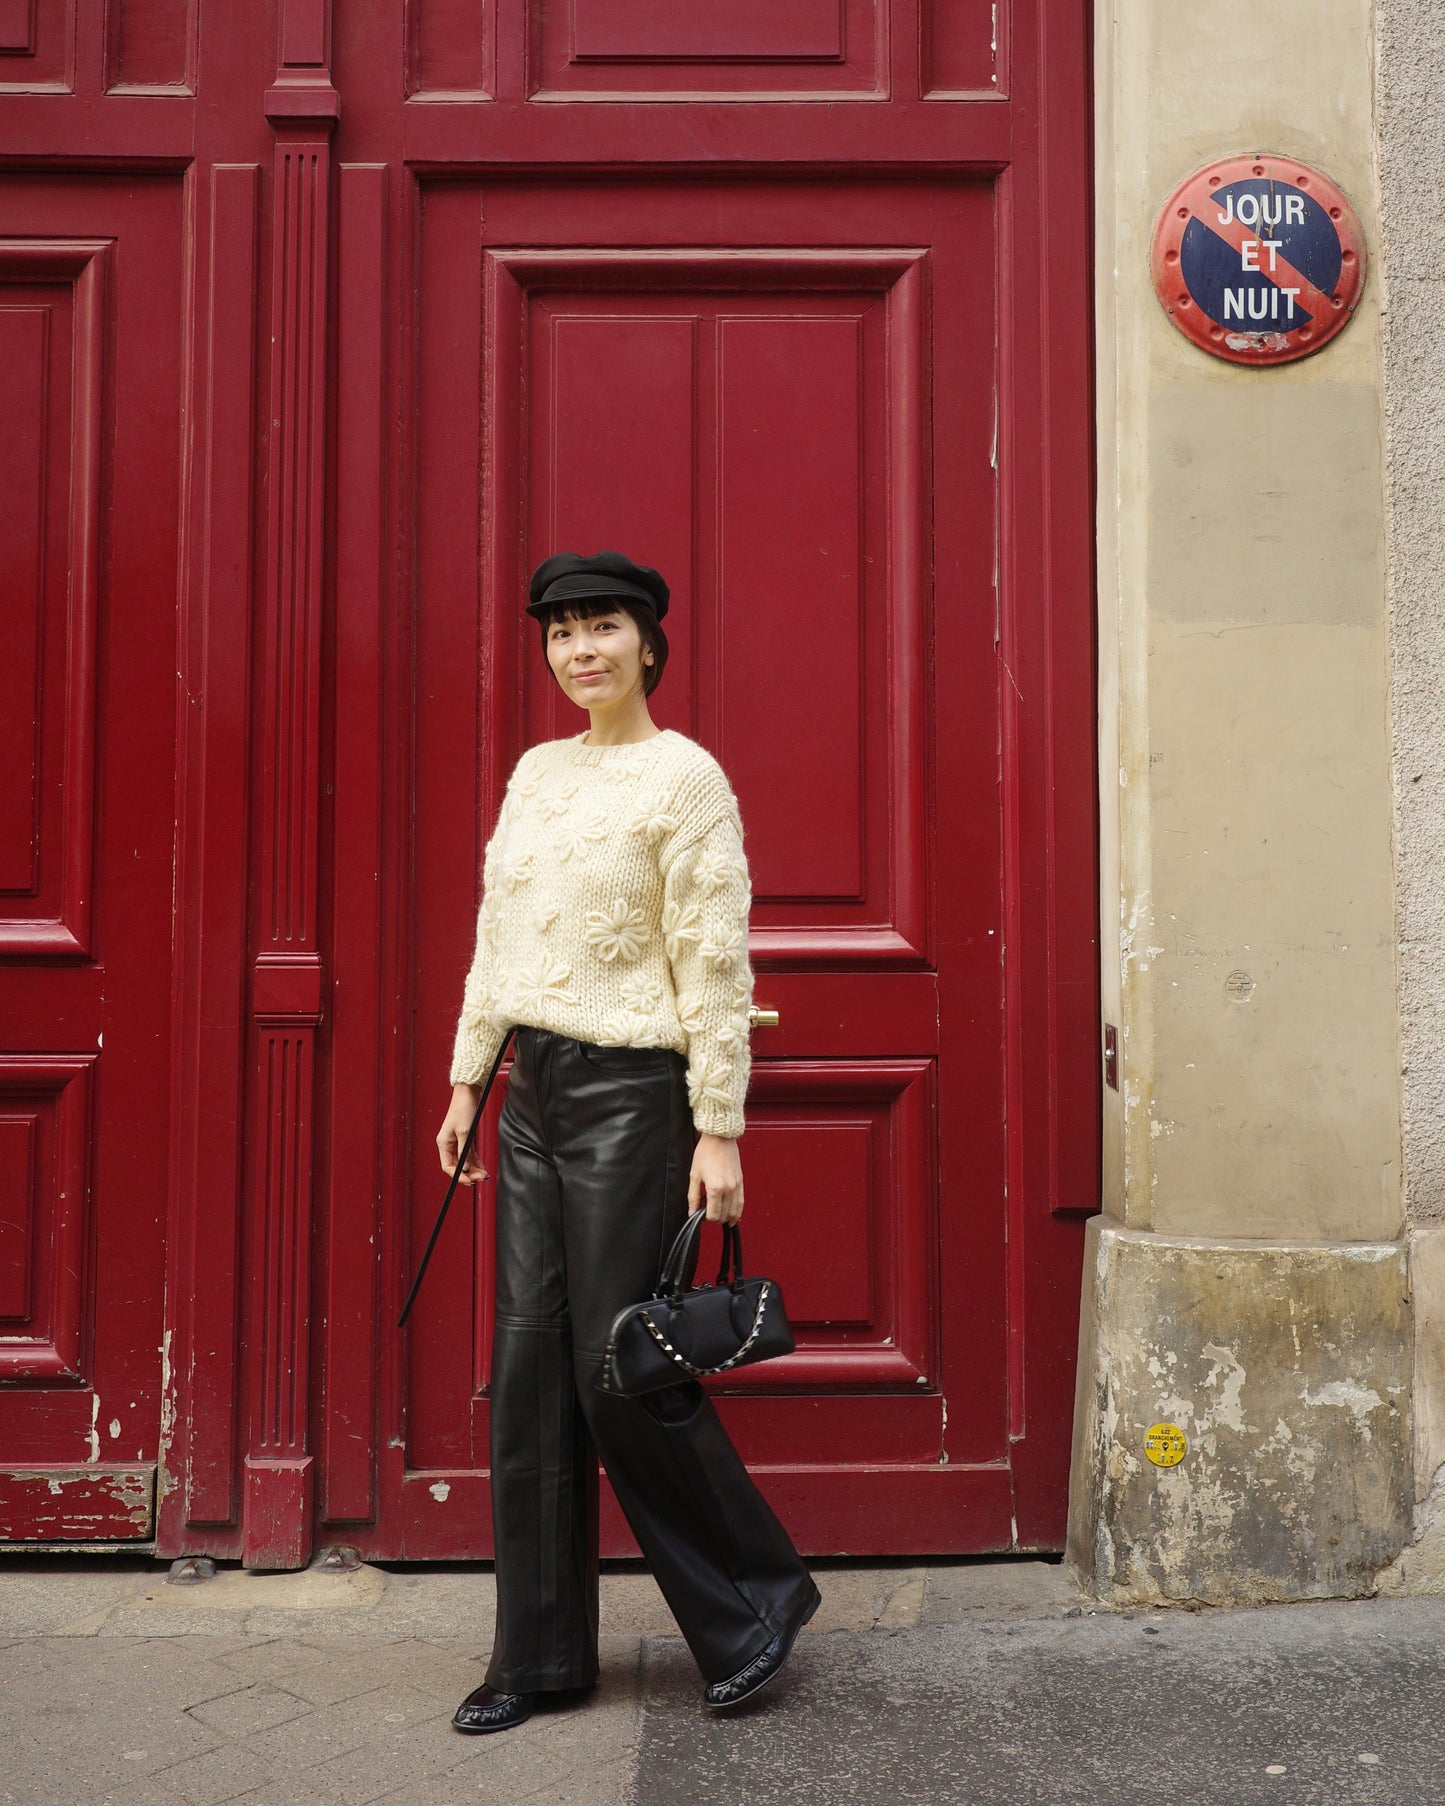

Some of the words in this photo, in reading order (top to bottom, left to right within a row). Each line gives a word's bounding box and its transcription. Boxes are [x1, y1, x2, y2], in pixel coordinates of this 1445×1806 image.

[1217, 194, 1305, 225] JOUR
[1241, 240, 1282, 272] ET
[1223, 287, 1301, 320] NUIT
